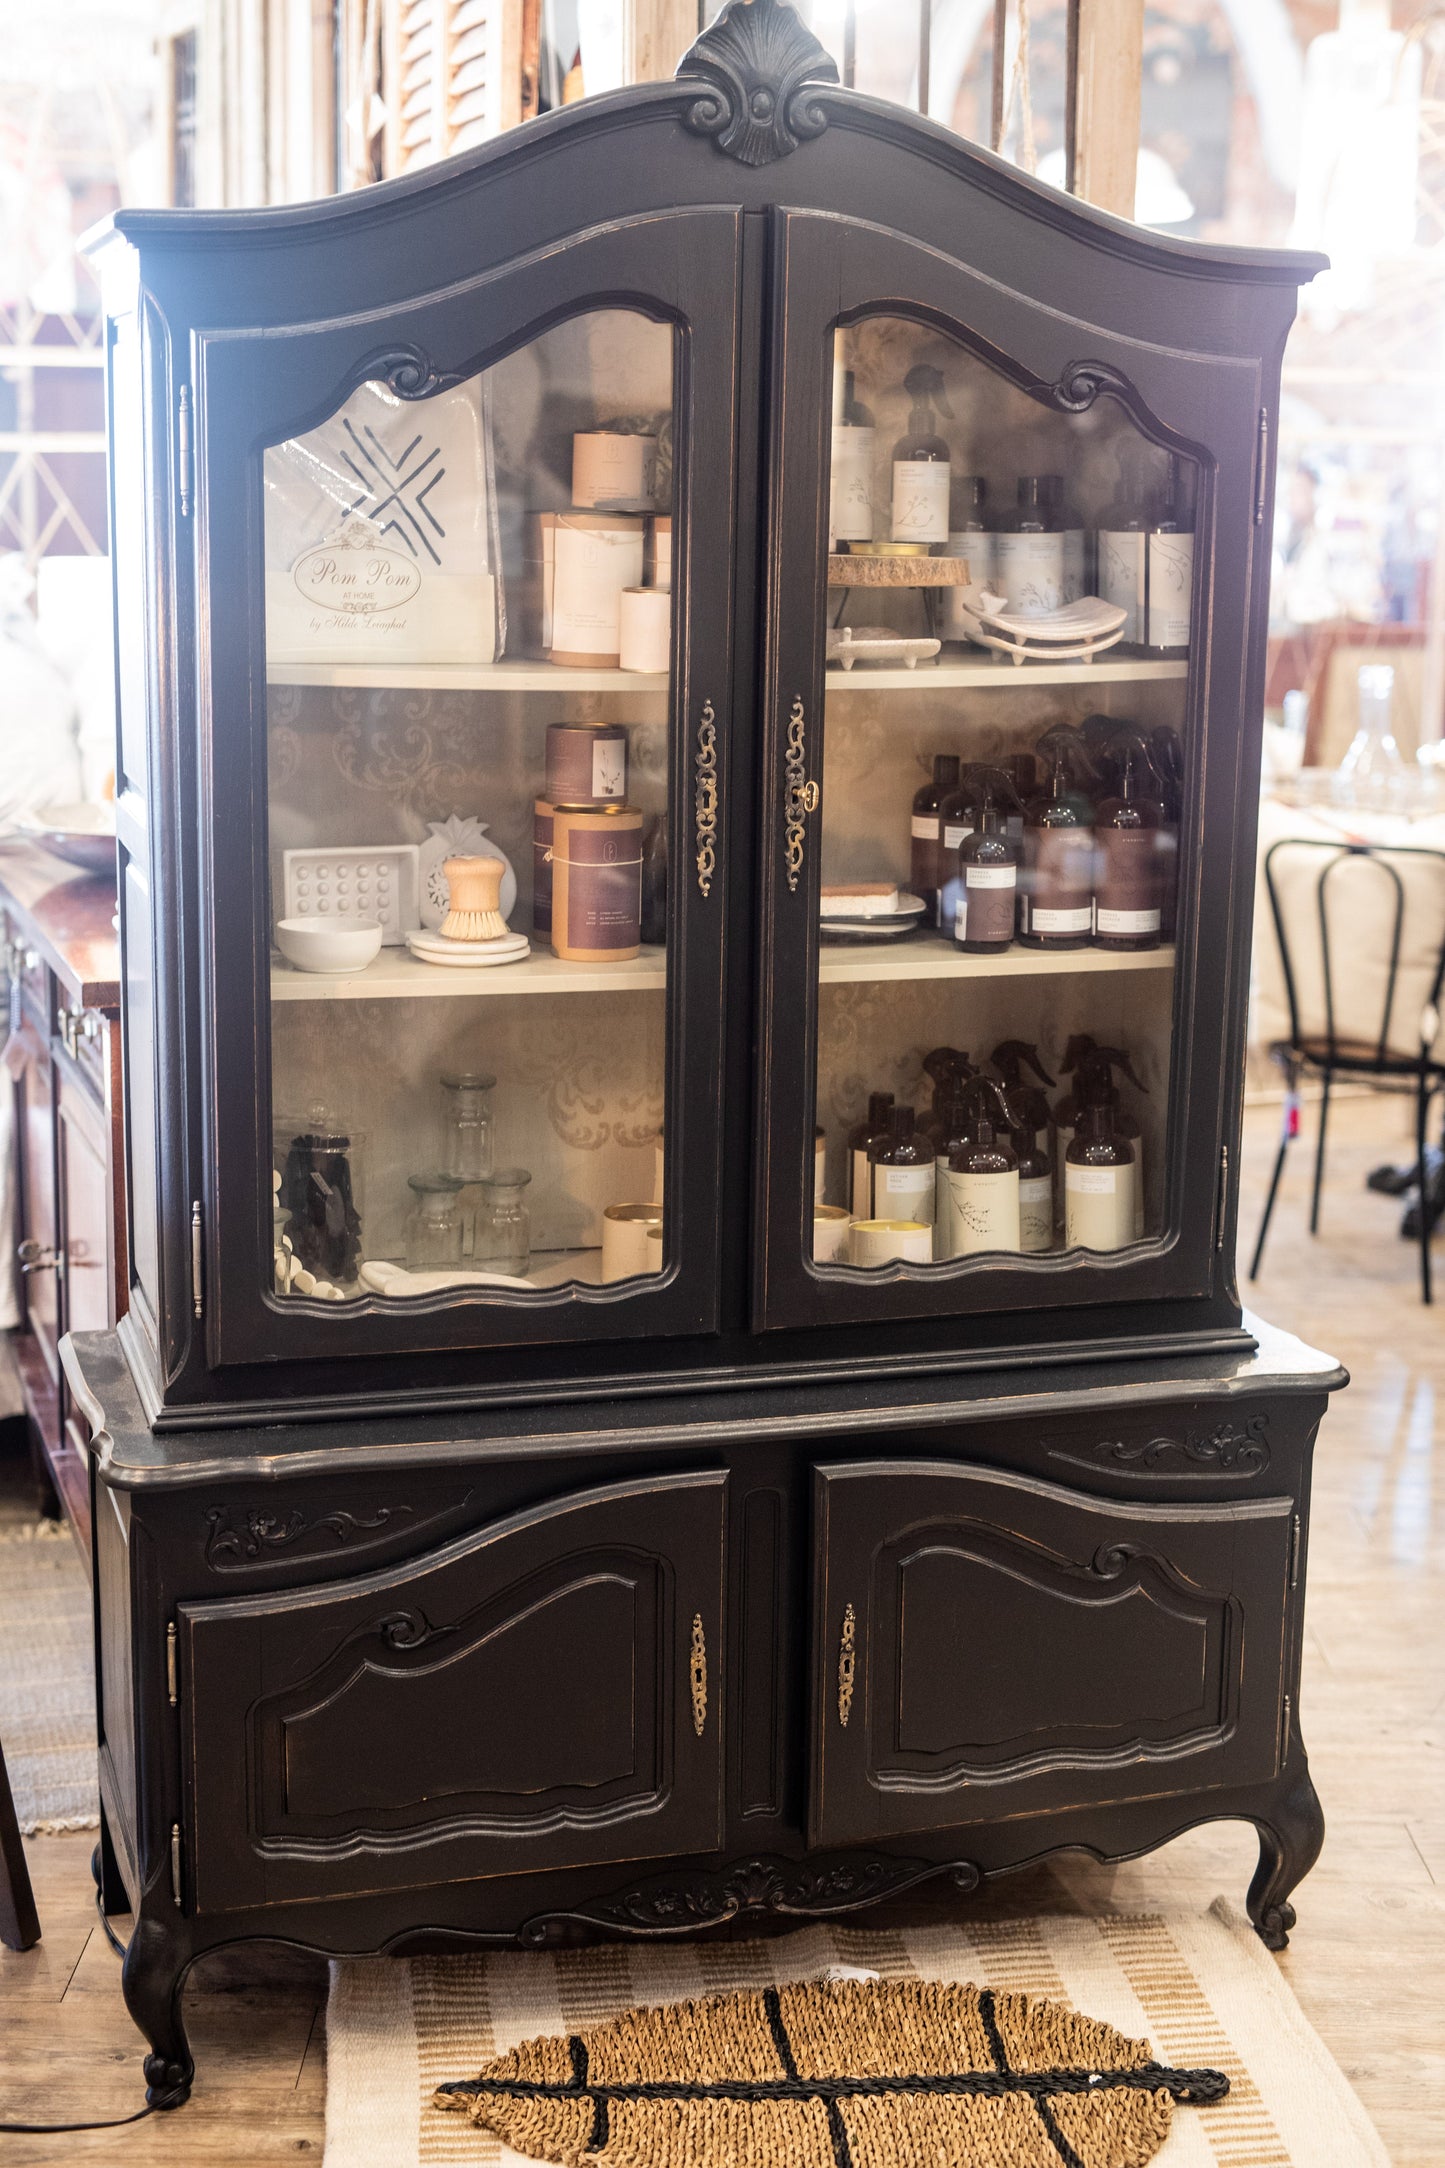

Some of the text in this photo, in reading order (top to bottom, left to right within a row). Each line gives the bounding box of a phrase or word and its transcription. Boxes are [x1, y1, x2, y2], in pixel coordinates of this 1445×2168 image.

[310, 558, 411, 586] Pom Pom
[309, 617, 321, 633] by
